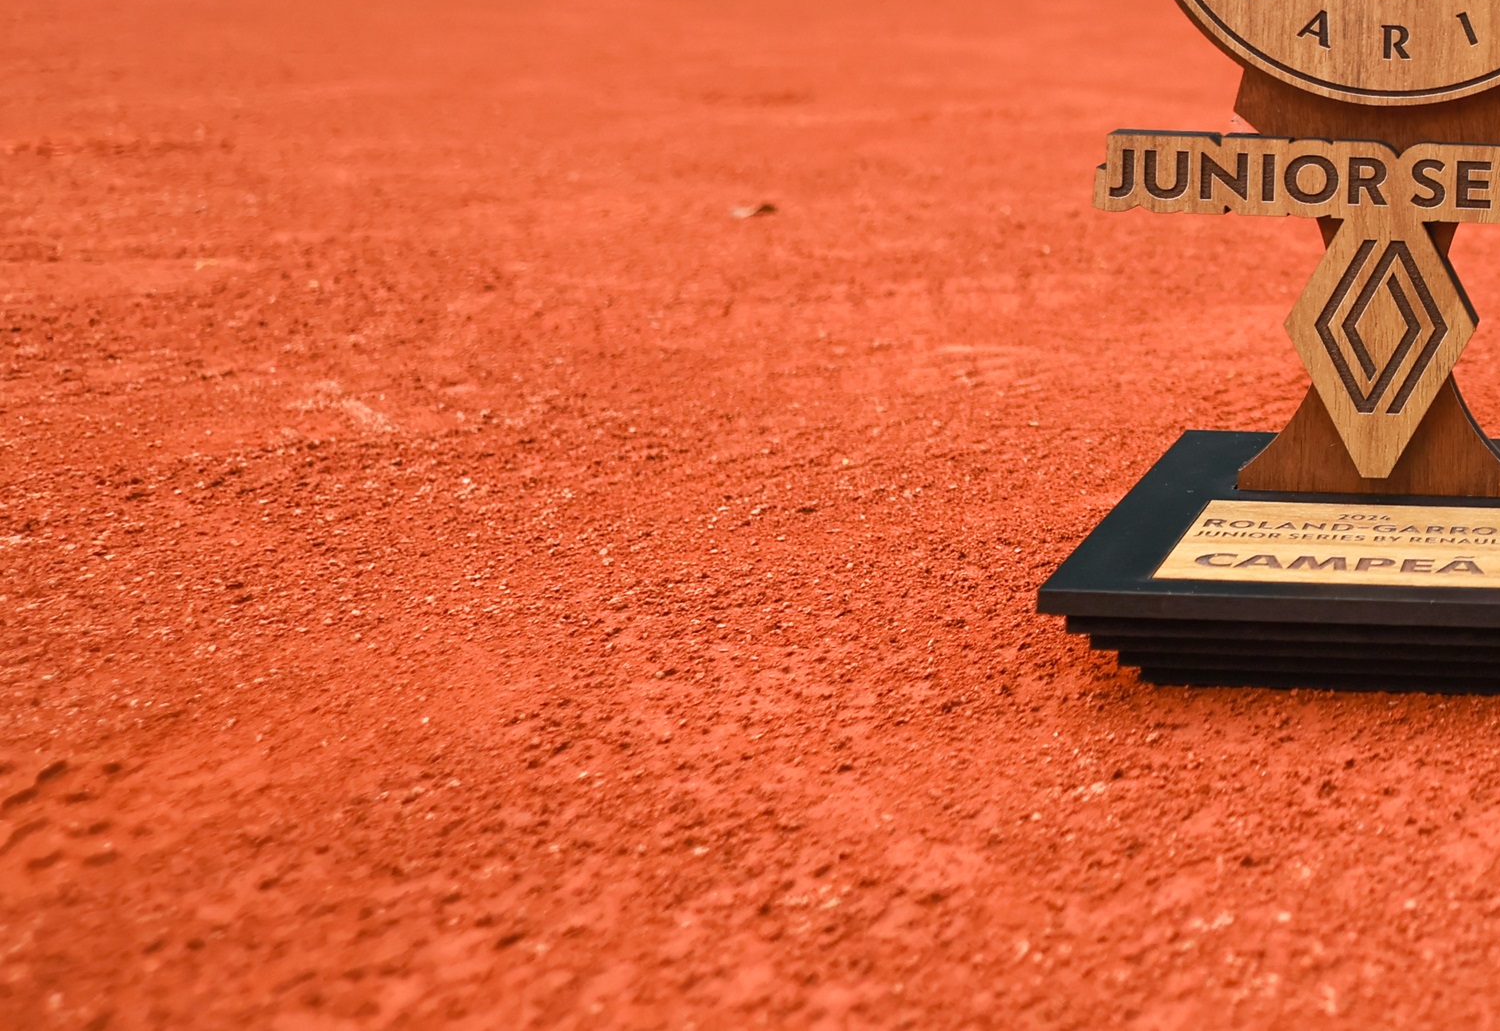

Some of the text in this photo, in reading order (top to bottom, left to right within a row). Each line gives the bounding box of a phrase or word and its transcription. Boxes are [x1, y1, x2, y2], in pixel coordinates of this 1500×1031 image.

[1109, 149, 1388, 207] JUNIOR
[1337, 513, 1391, 522] 2024
[1194, 530, 1282, 539] JUNIOR
[1288, 533, 1366, 542] SERIES
[1373, 535, 1402, 543] BY
[1194, 552, 1486, 576] CAMPEÃ
